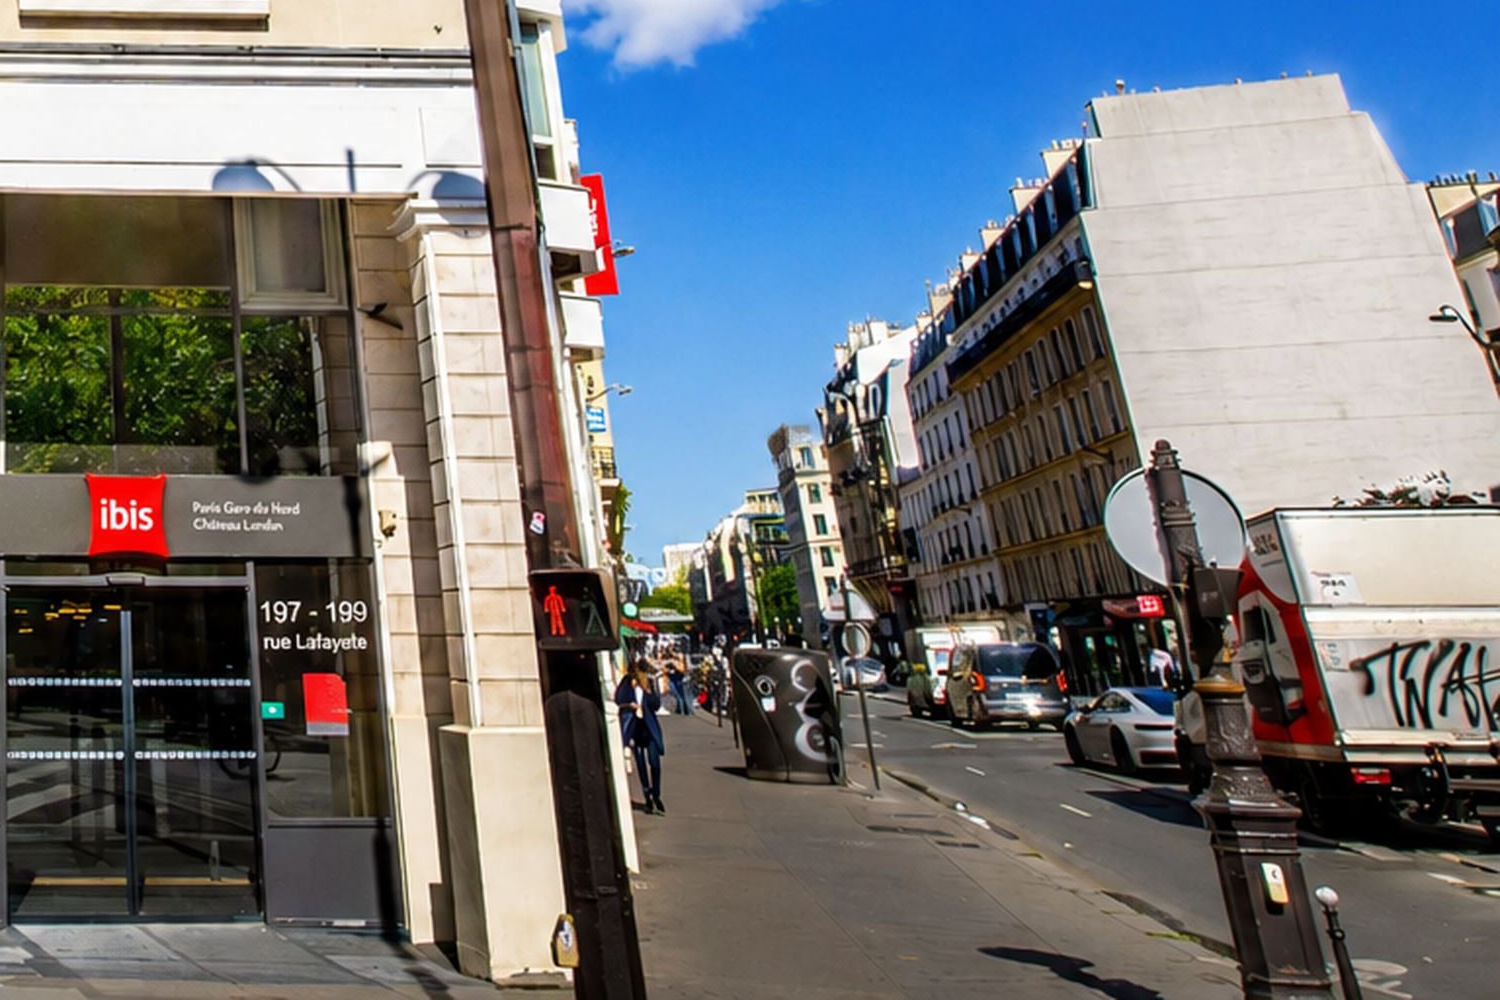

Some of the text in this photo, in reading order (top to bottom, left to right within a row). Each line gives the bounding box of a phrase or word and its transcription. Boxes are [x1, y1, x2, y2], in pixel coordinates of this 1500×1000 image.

[100, 498, 154, 531] ibis
[192, 501, 222, 514] Paris
[260, 600, 302, 624] 197
[325, 600, 368, 624] 199
[263, 636, 292, 650] rue
